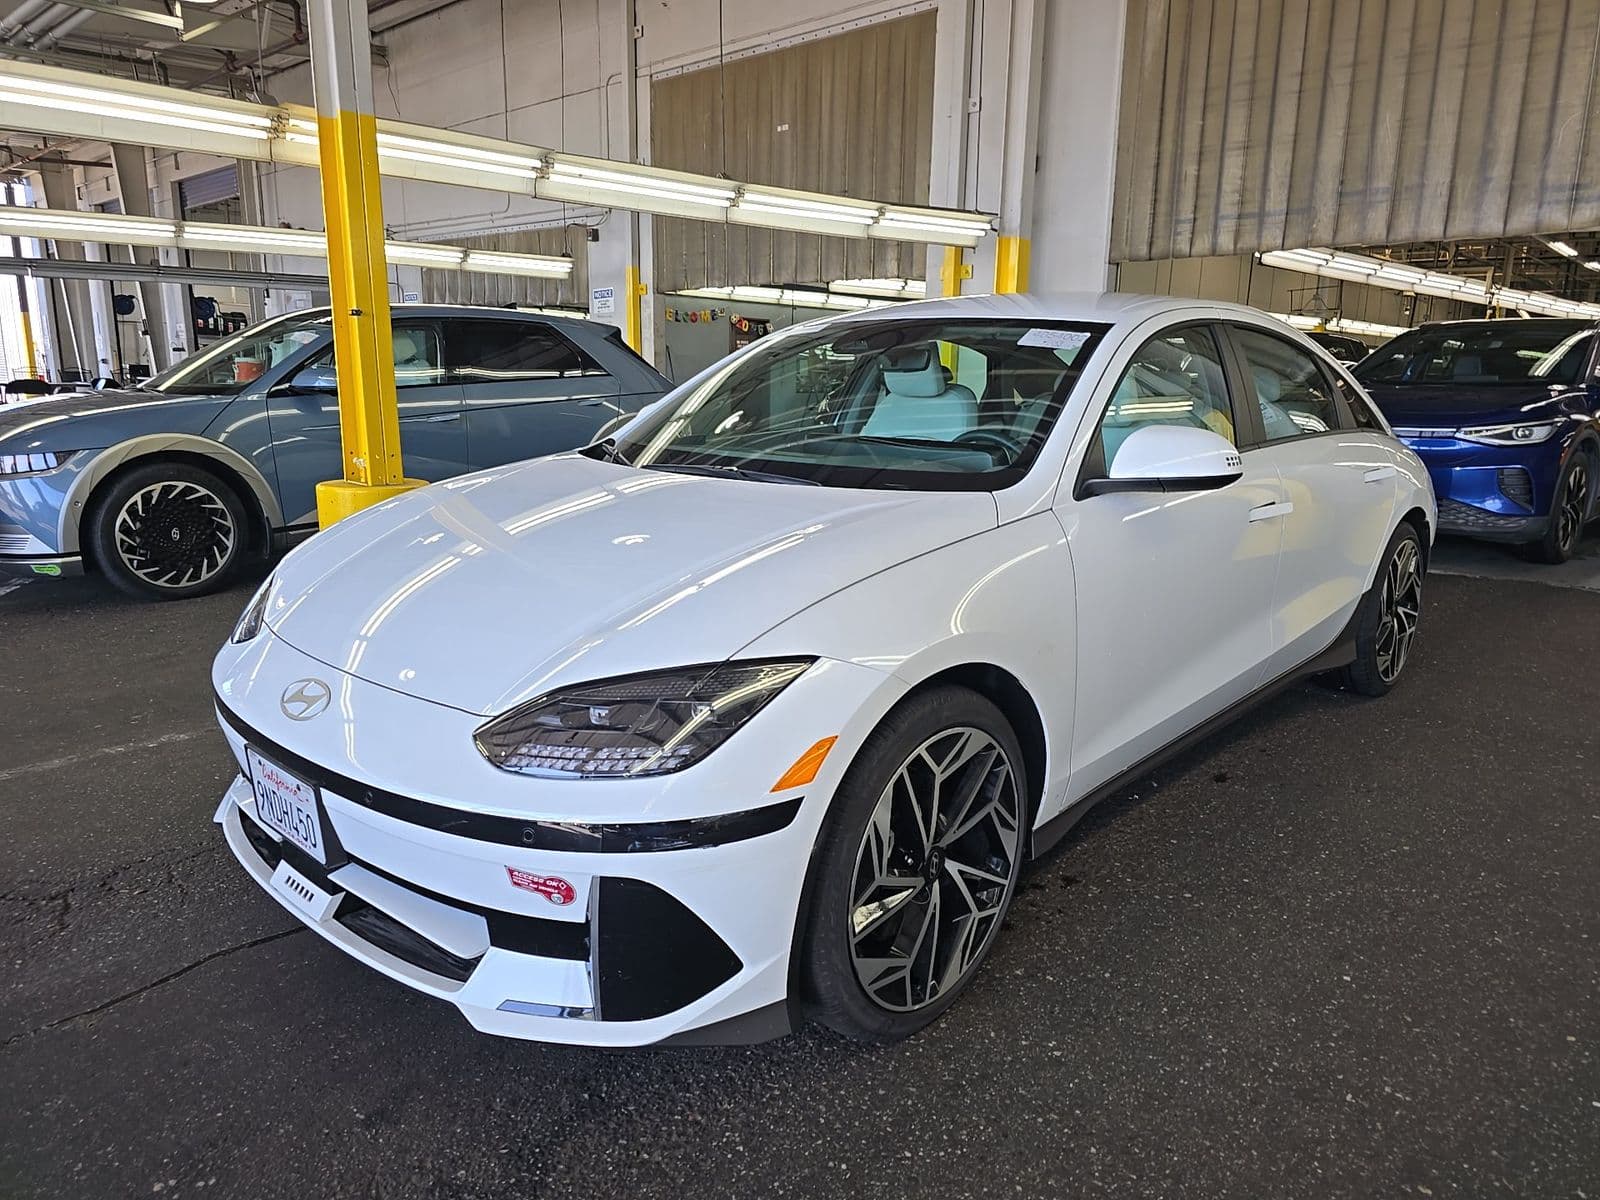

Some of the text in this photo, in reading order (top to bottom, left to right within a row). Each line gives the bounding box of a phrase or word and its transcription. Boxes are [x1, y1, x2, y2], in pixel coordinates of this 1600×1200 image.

[594, 289, 612, 298] NOTICE
[261, 763, 299, 797] California
[256, 779, 317, 849] 9NDH450
[512, 871, 544, 883] ACCESS
